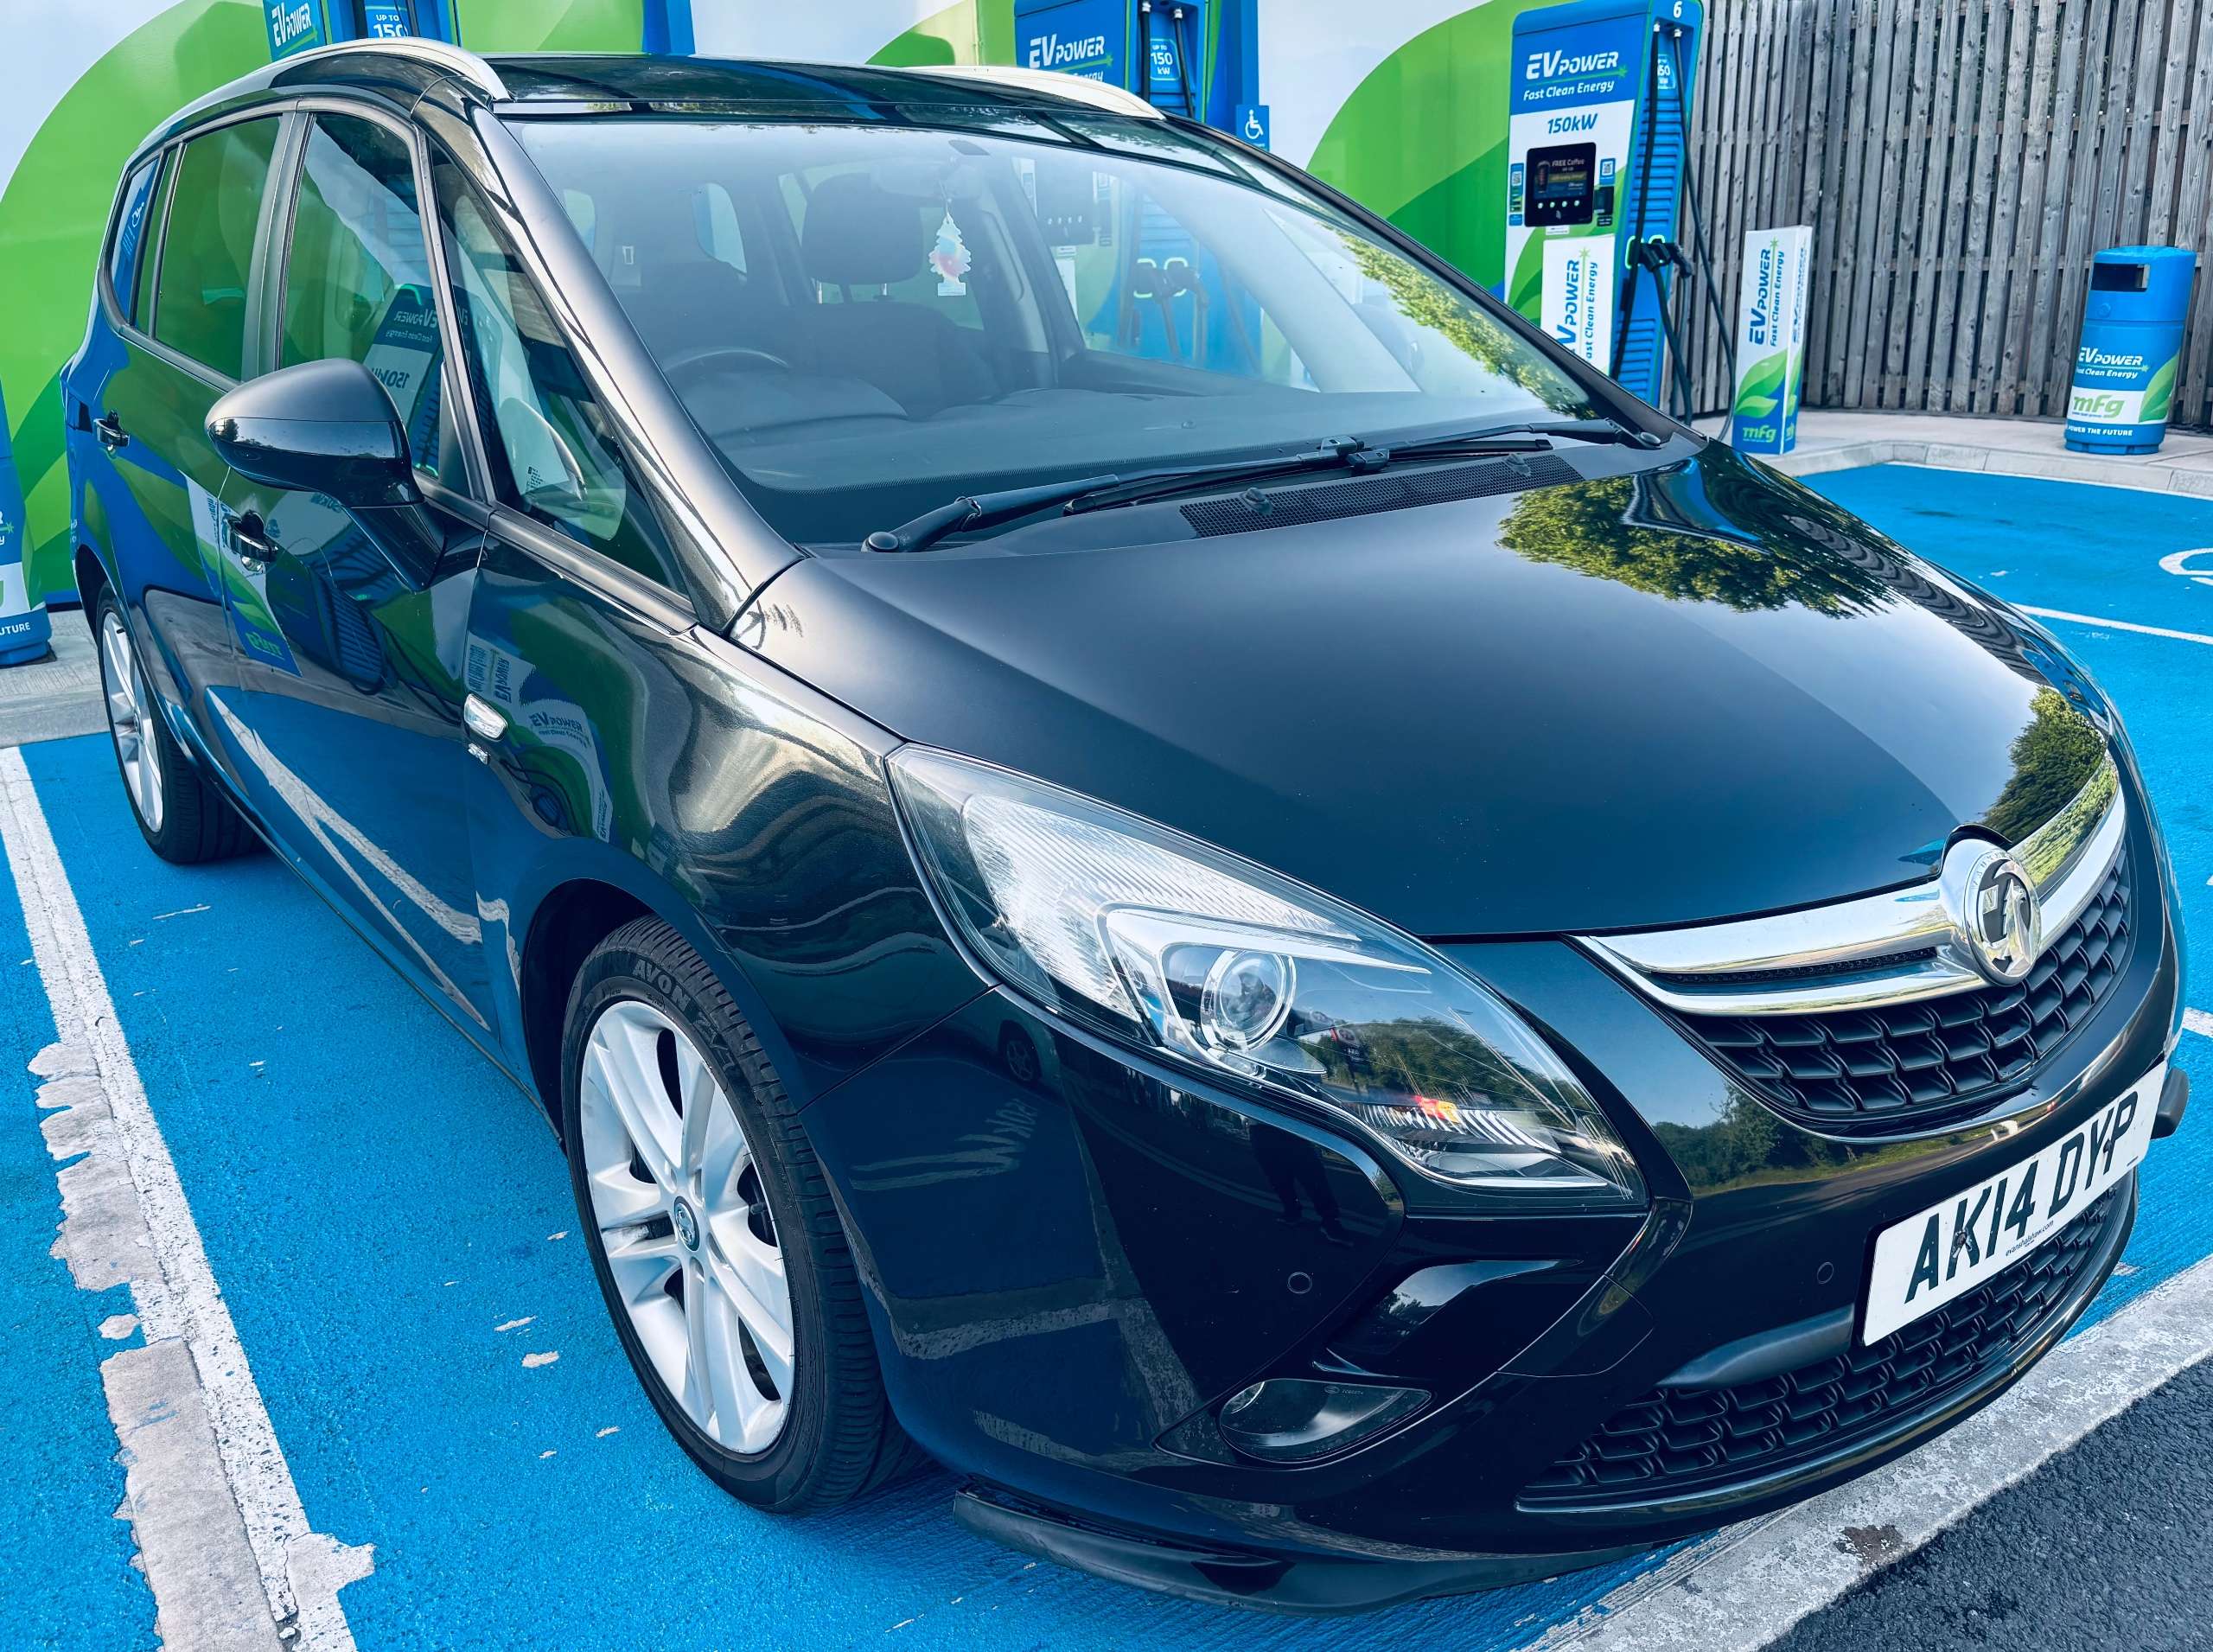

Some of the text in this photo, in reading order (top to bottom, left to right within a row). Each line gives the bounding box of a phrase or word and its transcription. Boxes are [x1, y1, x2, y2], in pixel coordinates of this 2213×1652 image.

[1673, 1, 1682, 18] 6
[1151, 52, 1173, 66] 150
[1523, 80, 1615, 101] Fast Clean Energy
[1547, 113, 1598, 134] 150kW
[1774, 251, 1784, 290] Energy
[1586, 262, 1598, 303] Energy
[1557, 259, 1579, 354] VPOWER
[1771, 292, 1781, 322] Clean
[1585, 305, 1595, 338] Clean
[2085, 367, 2105, 377] Clean
[2107, 368, 2139, 380] Energy
[2073, 394, 2125, 419] mfg
[1742, 424, 1777, 443] mfg
[2102, 428, 2133, 437] FUTURE
[0, 622, 31, 635] UTURE
[632, 959, 692, 1011] AVON
[1904, 1090, 2139, 1304] AK14 DYP
